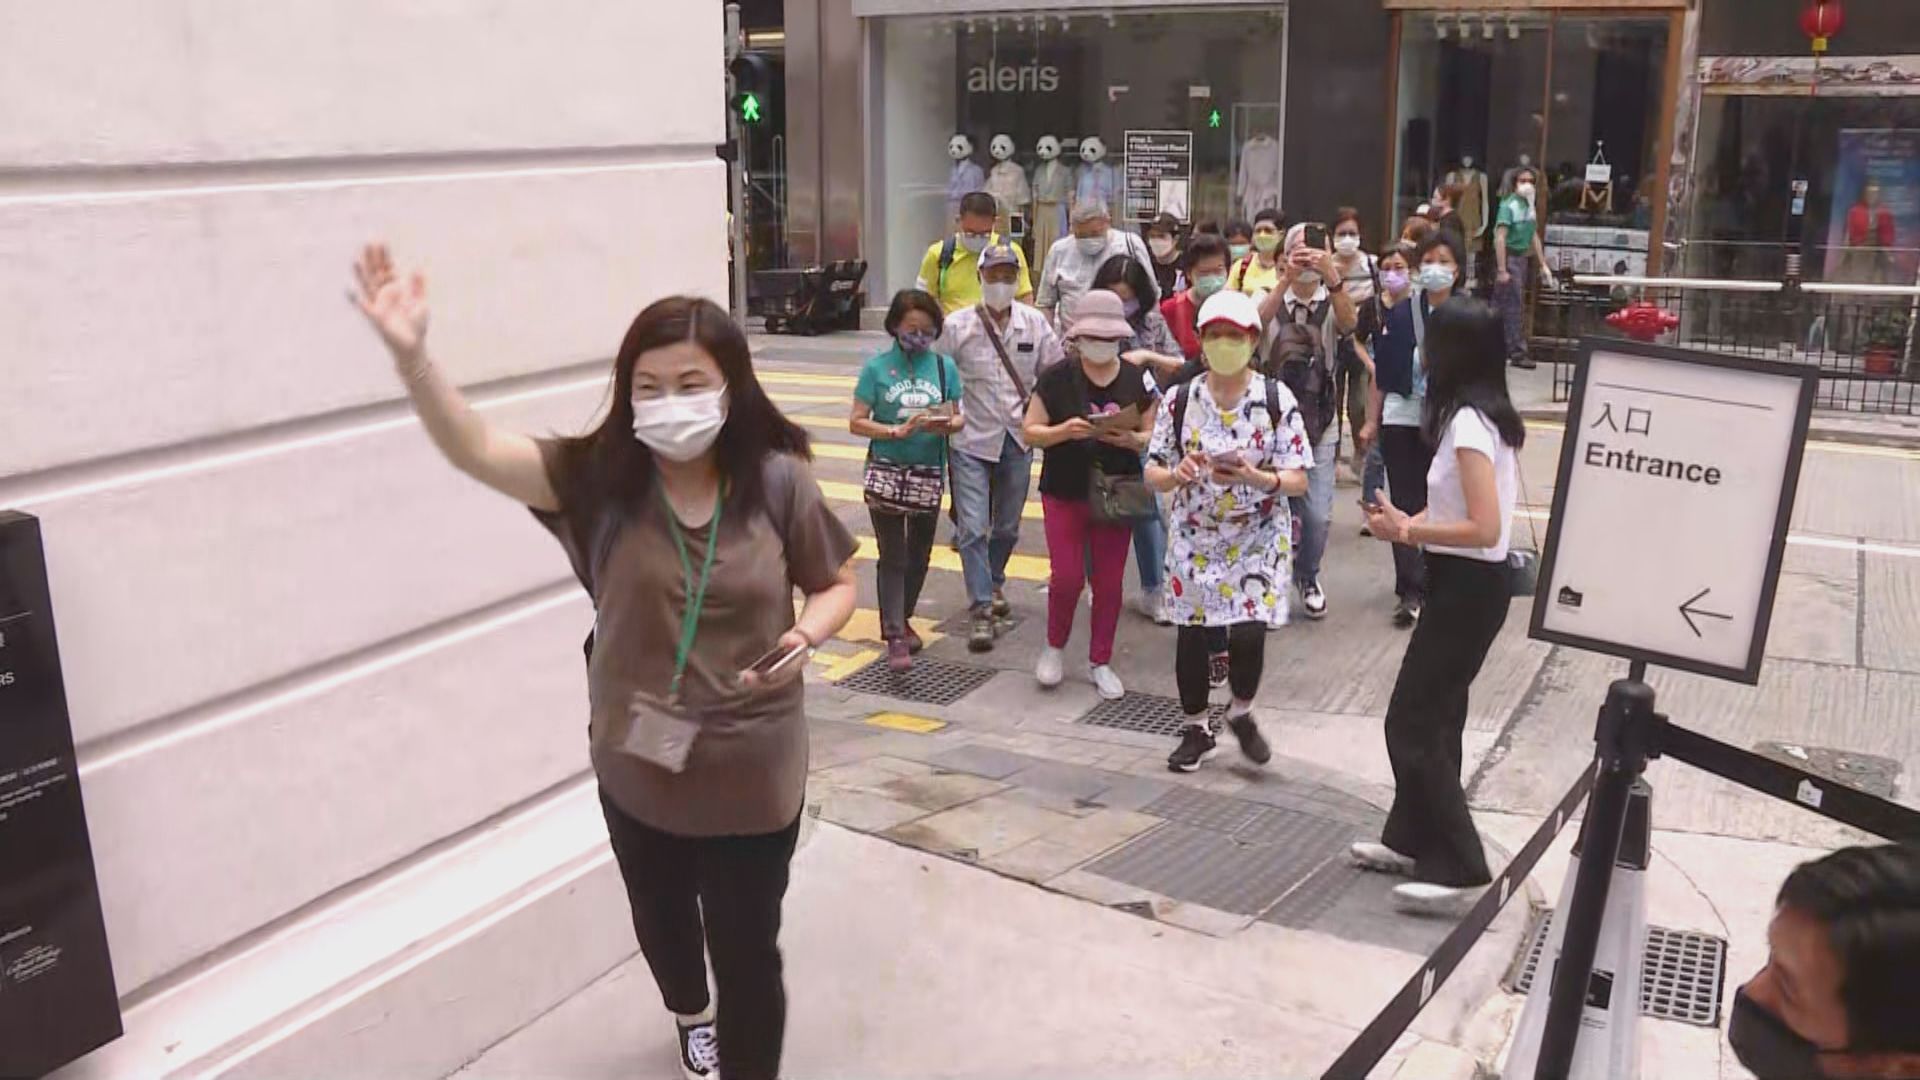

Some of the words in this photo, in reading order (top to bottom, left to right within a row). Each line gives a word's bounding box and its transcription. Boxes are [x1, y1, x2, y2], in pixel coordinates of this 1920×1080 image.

[967, 58, 1060, 92] aleris
[1591, 402, 1651, 436] 入口
[1584, 441, 1722, 487] Entrance
